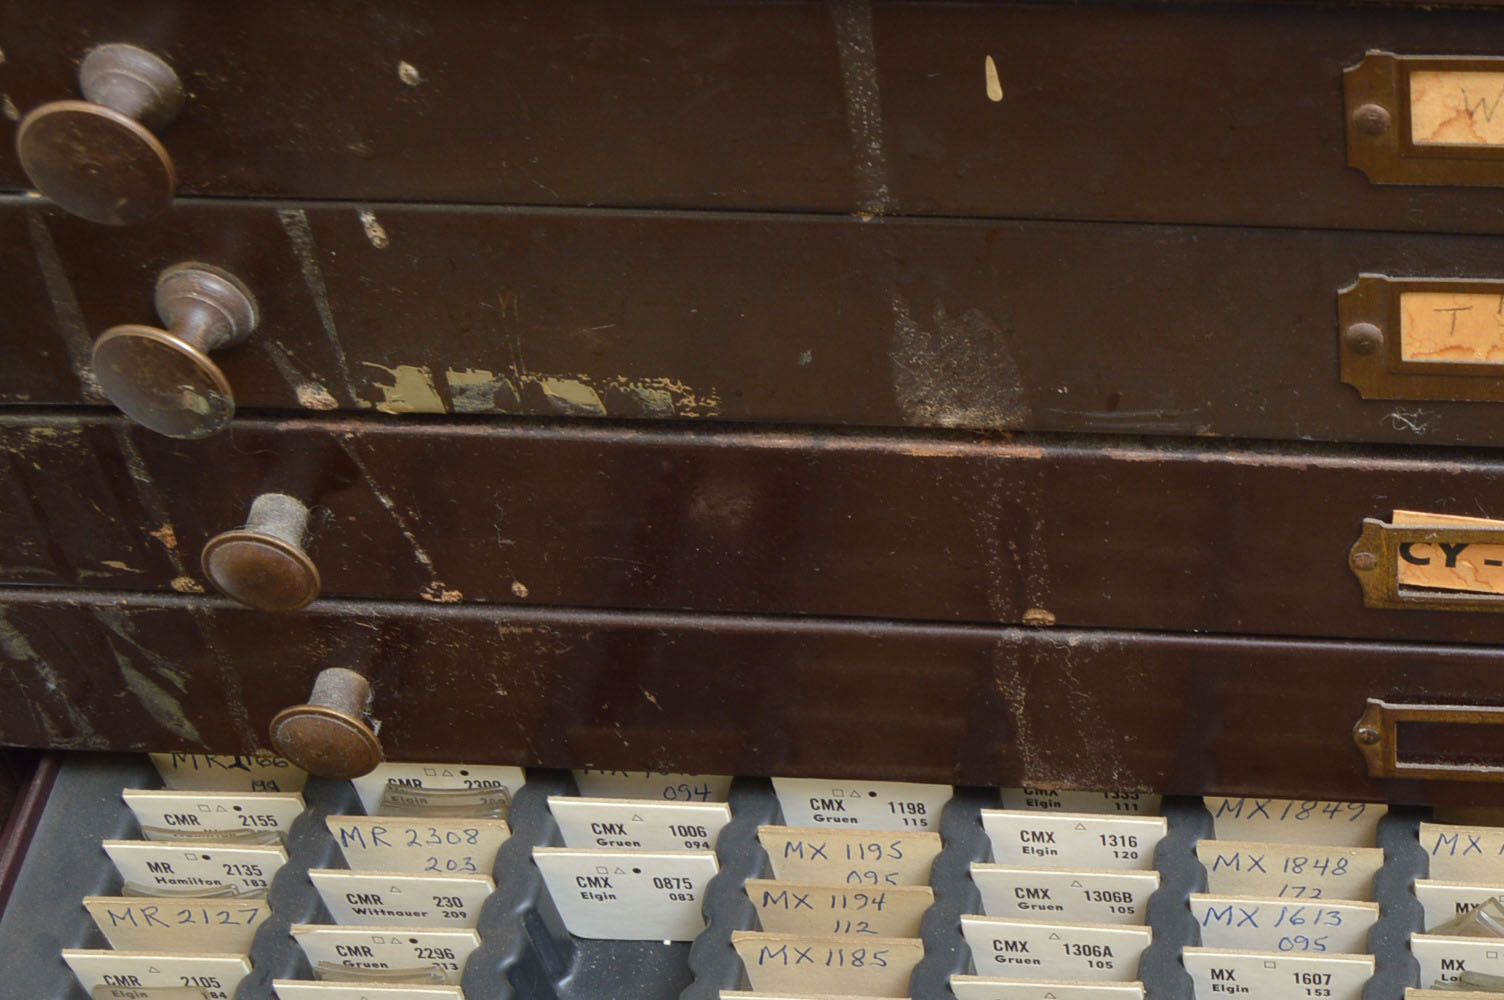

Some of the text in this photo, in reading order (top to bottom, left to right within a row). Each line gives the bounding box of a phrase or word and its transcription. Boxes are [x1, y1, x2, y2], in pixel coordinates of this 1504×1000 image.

[591, 823, 707, 837] CMX 1006
[340, 826, 479, 849] MR 2308
[596, 838, 711, 850] Gruen 094
[1020, 830, 1137, 847] CMX 1316
[1432, 833, 1482, 856] MX
[1022, 846, 1138, 859] Elgin 120
[425, 857, 477, 873] 203
[576, 876, 692, 889] CMX 0875
[346, 894, 463, 908] CMR 230
[580, 892, 694, 901] Elgin 083
[763, 890, 885, 911] MX 1194
[1015, 887, 1133, 903] CMX 1306B
[352, 907, 428, 917] Wittnauer
[1018, 902, 1135, 914] Gruen 105
[1203, 905, 1342, 928] MX 1613
[834, 920, 878, 934] 112
[1278, 935, 1328, 952] 095
[1211, 969, 1331, 985] MX 1607
[1212, 984, 1330, 996] Elgin 153
